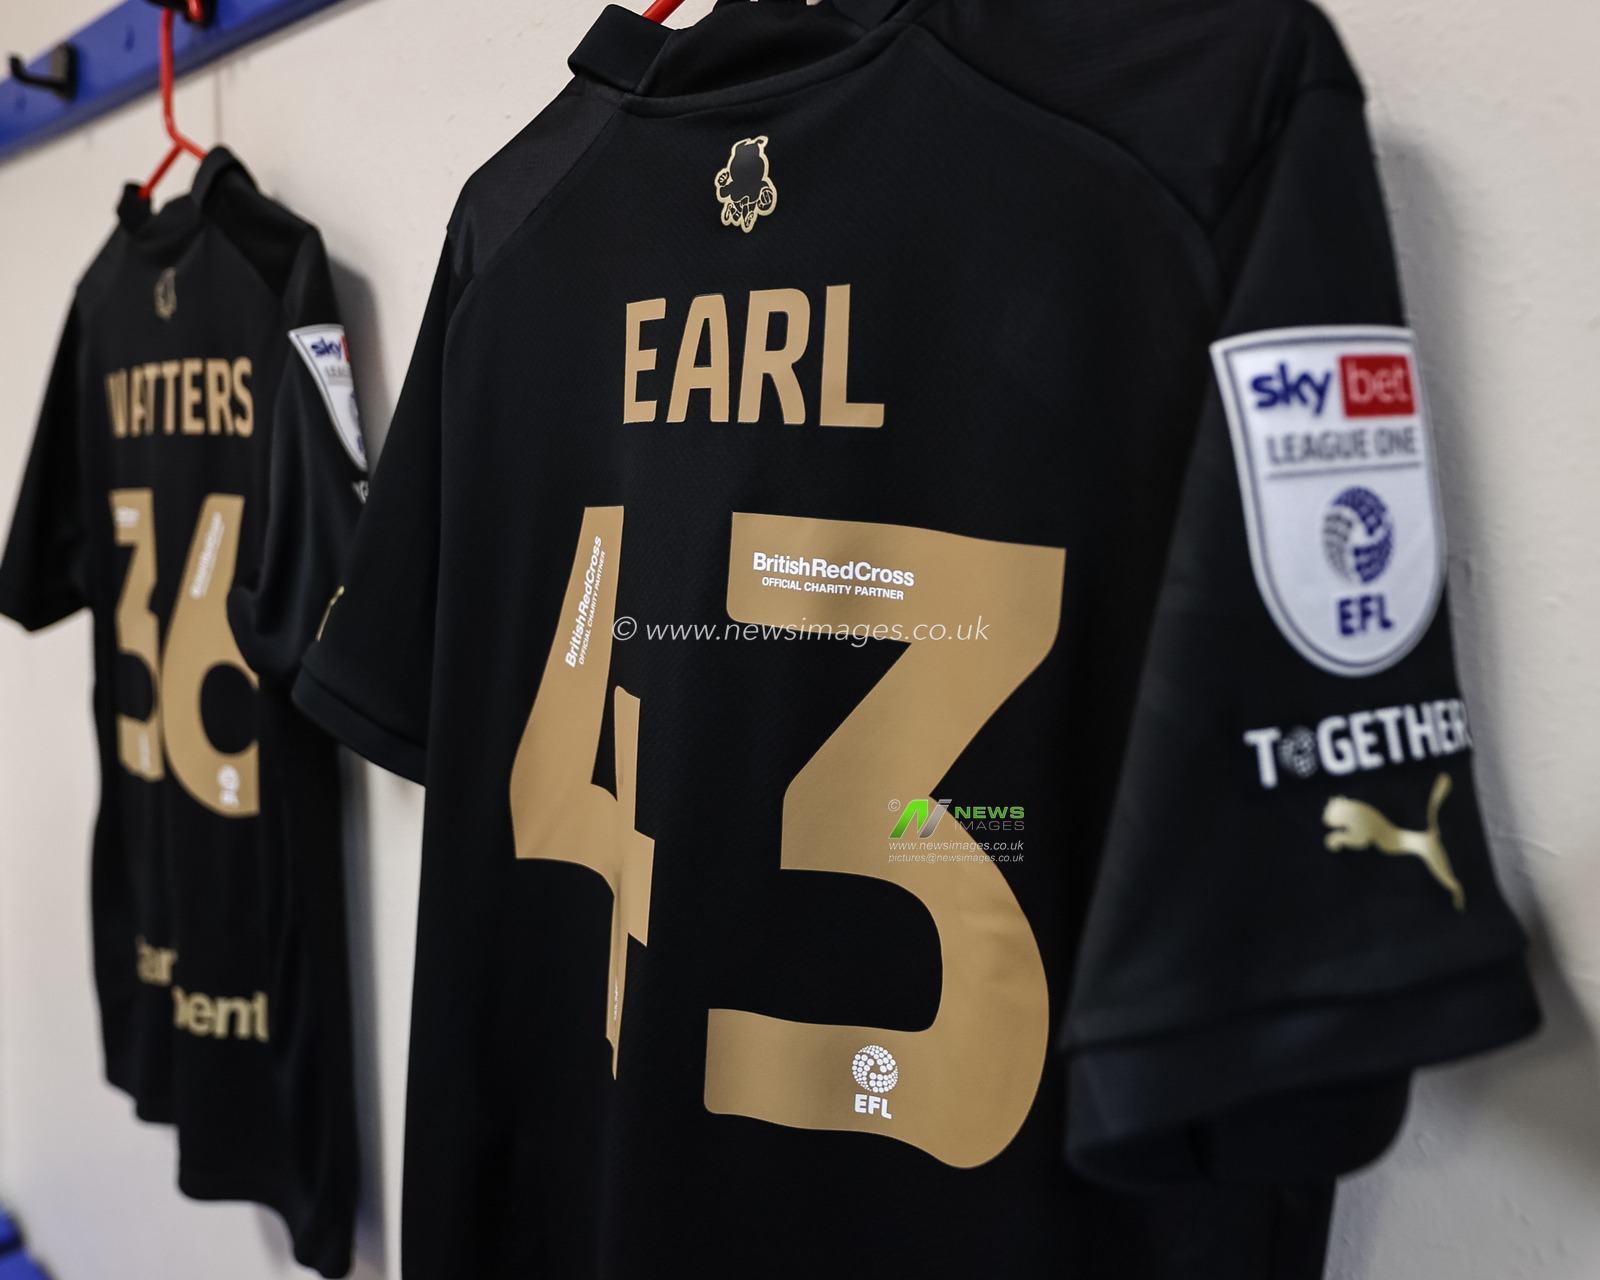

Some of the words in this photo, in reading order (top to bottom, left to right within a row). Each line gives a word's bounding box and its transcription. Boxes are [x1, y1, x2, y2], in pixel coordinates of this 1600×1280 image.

[310, 337, 342, 360] sky
[623, 284, 885, 428] EARL
[104, 356, 254, 438] WATTERS
[1251, 363, 1331, 416] sky
[1345, 359, 1410, 403] bet
[1266, 428, 1369, 464] LEAGUE
[1374, 426, 1417, 457] ONE
[578, 629, 592, 665] OFFICIAL
[588, 591, 599, 627] CHARITY
[595, 550, 606, 591] PARTNER
[761, 576, 802, 591] OFFICIAL
[804, 582, 851, 595] CHARITY
[854, 585, 905, 600] PARTNER
[1337, 594, 1393, 636] EFL
[108, 487, 261, 818] 36
[510, 505, 1066, 1168] 43
[855, 1094, 892, 1120] EFL
